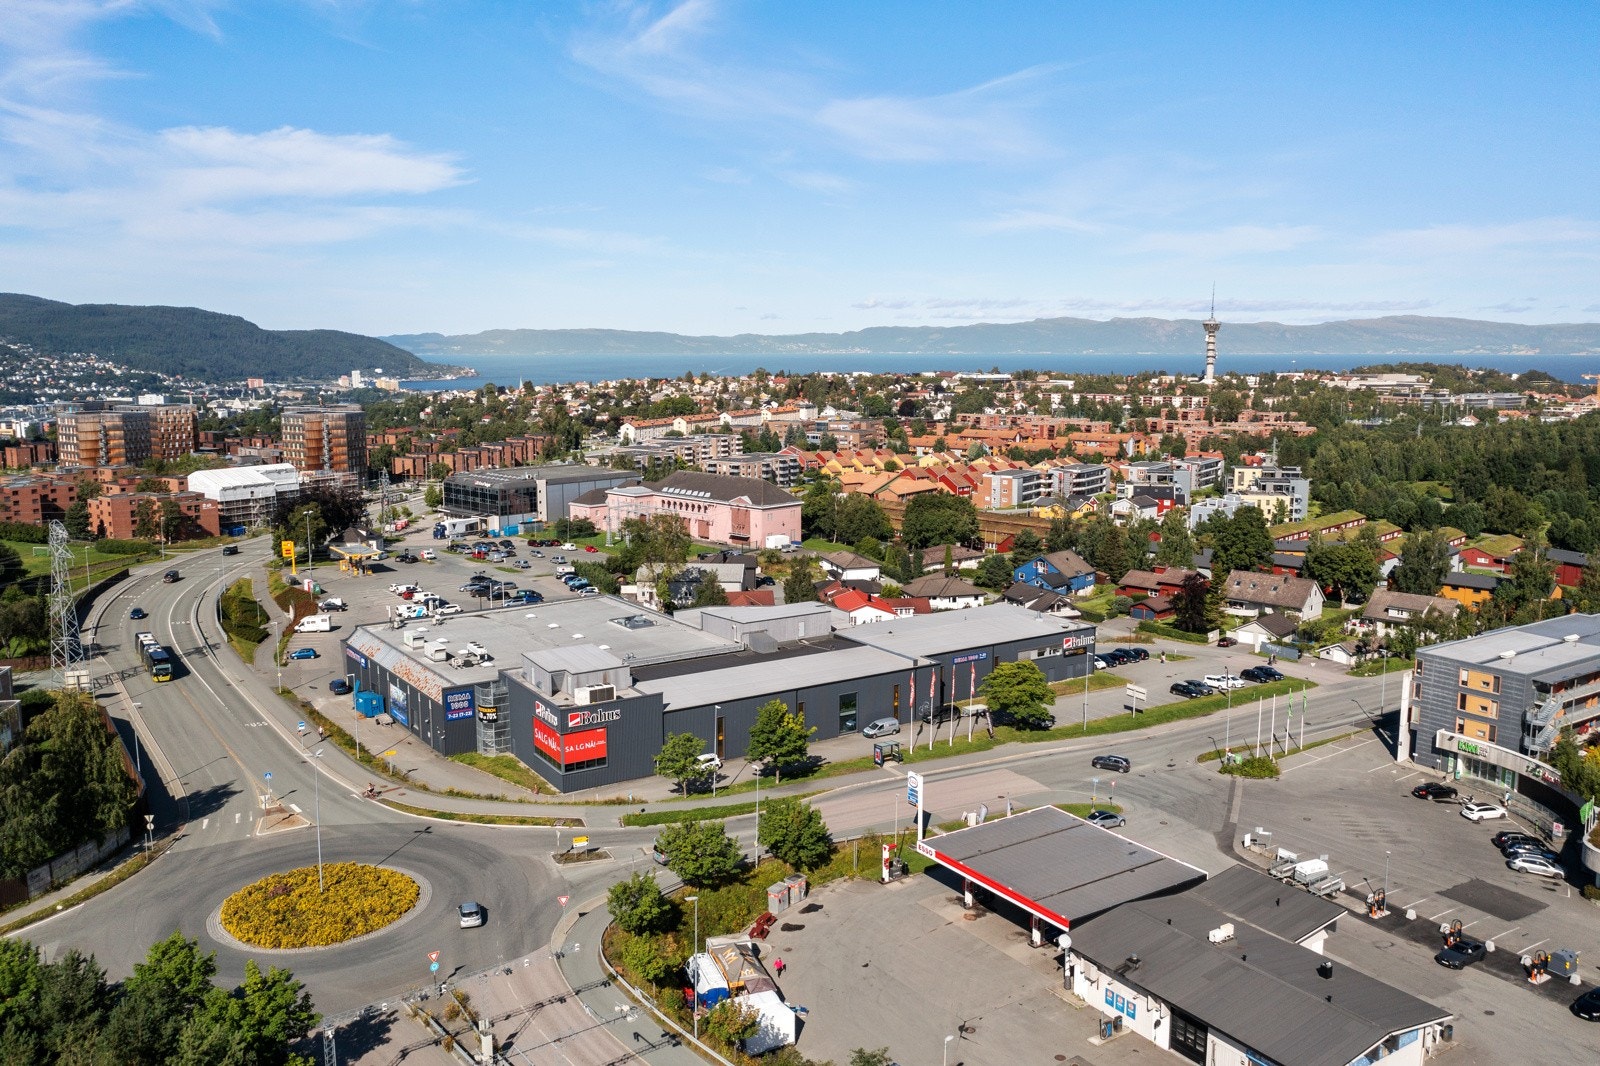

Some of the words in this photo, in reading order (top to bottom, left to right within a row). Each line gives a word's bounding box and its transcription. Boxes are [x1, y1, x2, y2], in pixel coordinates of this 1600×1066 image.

[447, 693, 471, 702] REMA
[450, 701, 469, 709] 1000
[580, 709, 621, 725] Bohus
[918, 844, 933, 856] ESSO
